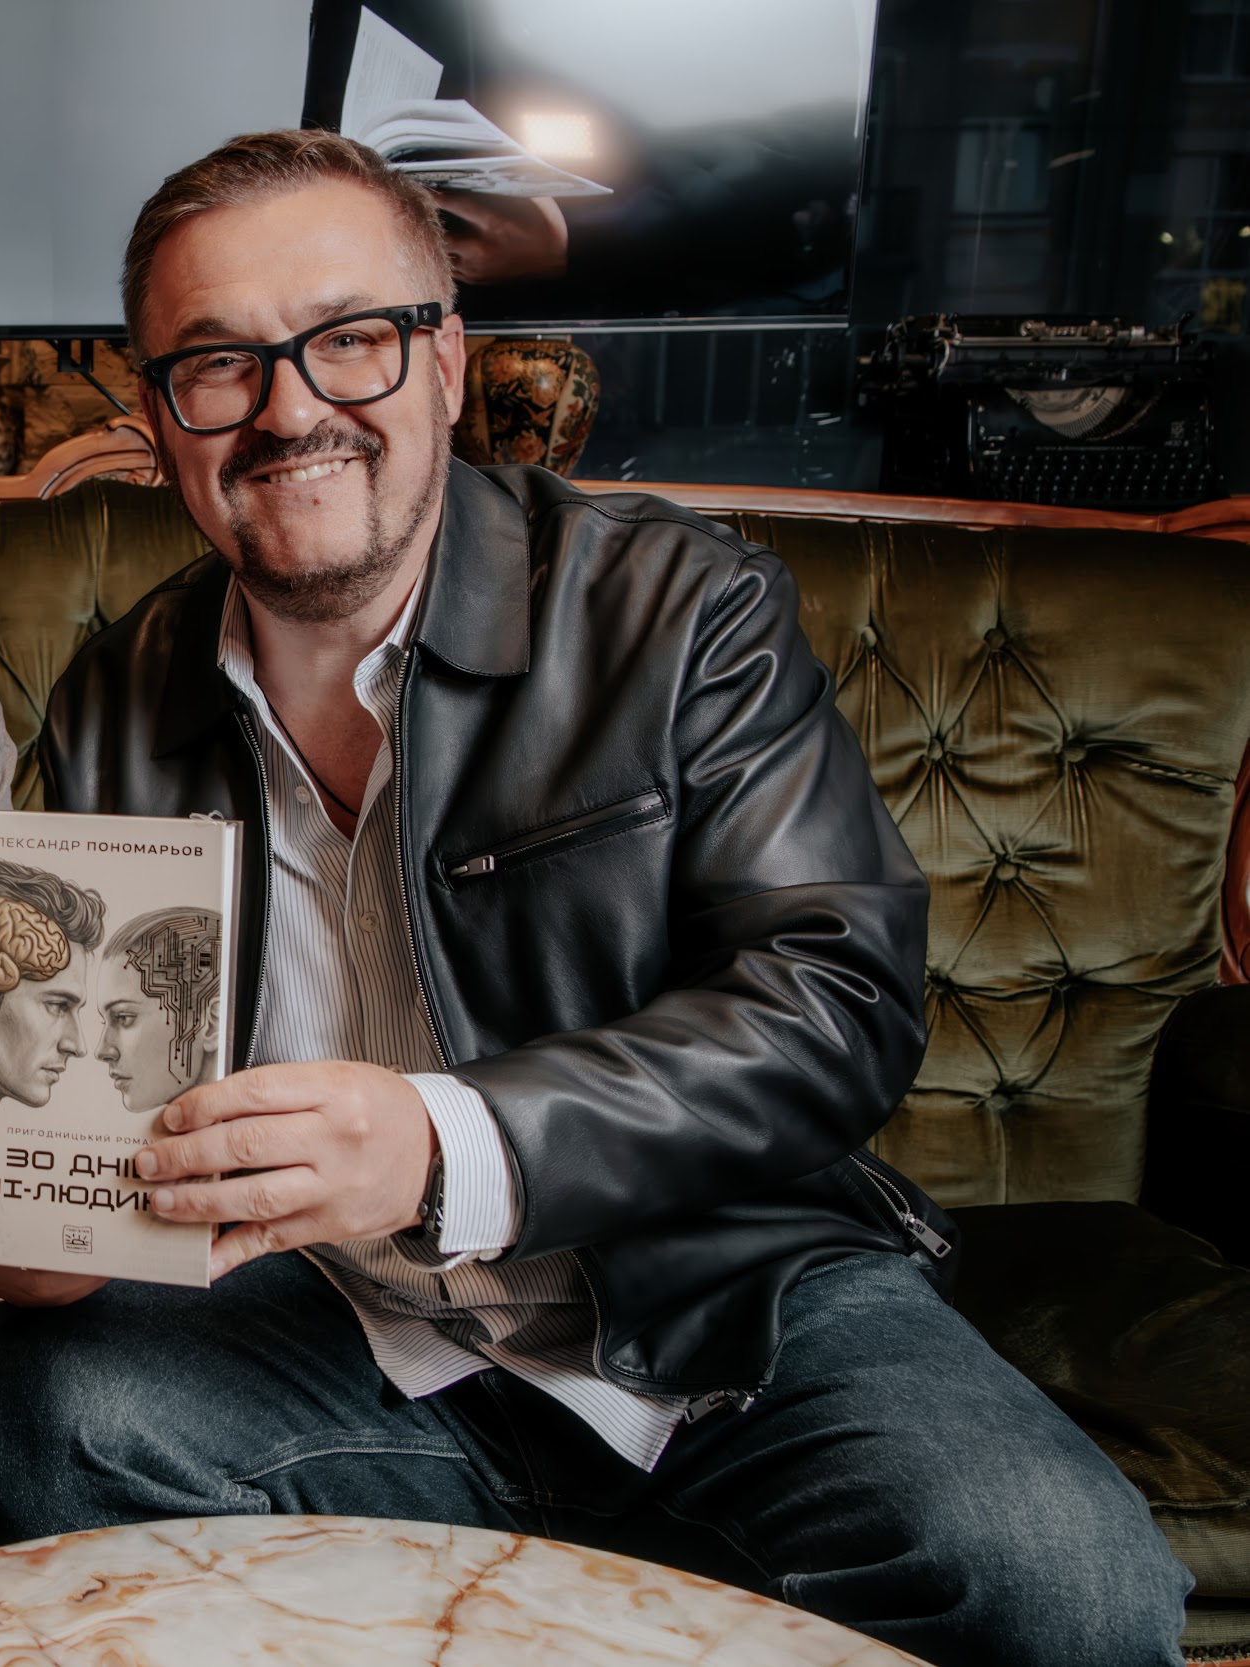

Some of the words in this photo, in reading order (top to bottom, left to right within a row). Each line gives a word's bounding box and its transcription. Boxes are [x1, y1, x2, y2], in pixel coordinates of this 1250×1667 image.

[87, 841, 204, 857] ПОНОМАРЬОВ
[7, 1127, 111, 1143] ПРИГОДНИЦЬКИЙ
[6, 1148, 54, 1170] 30
